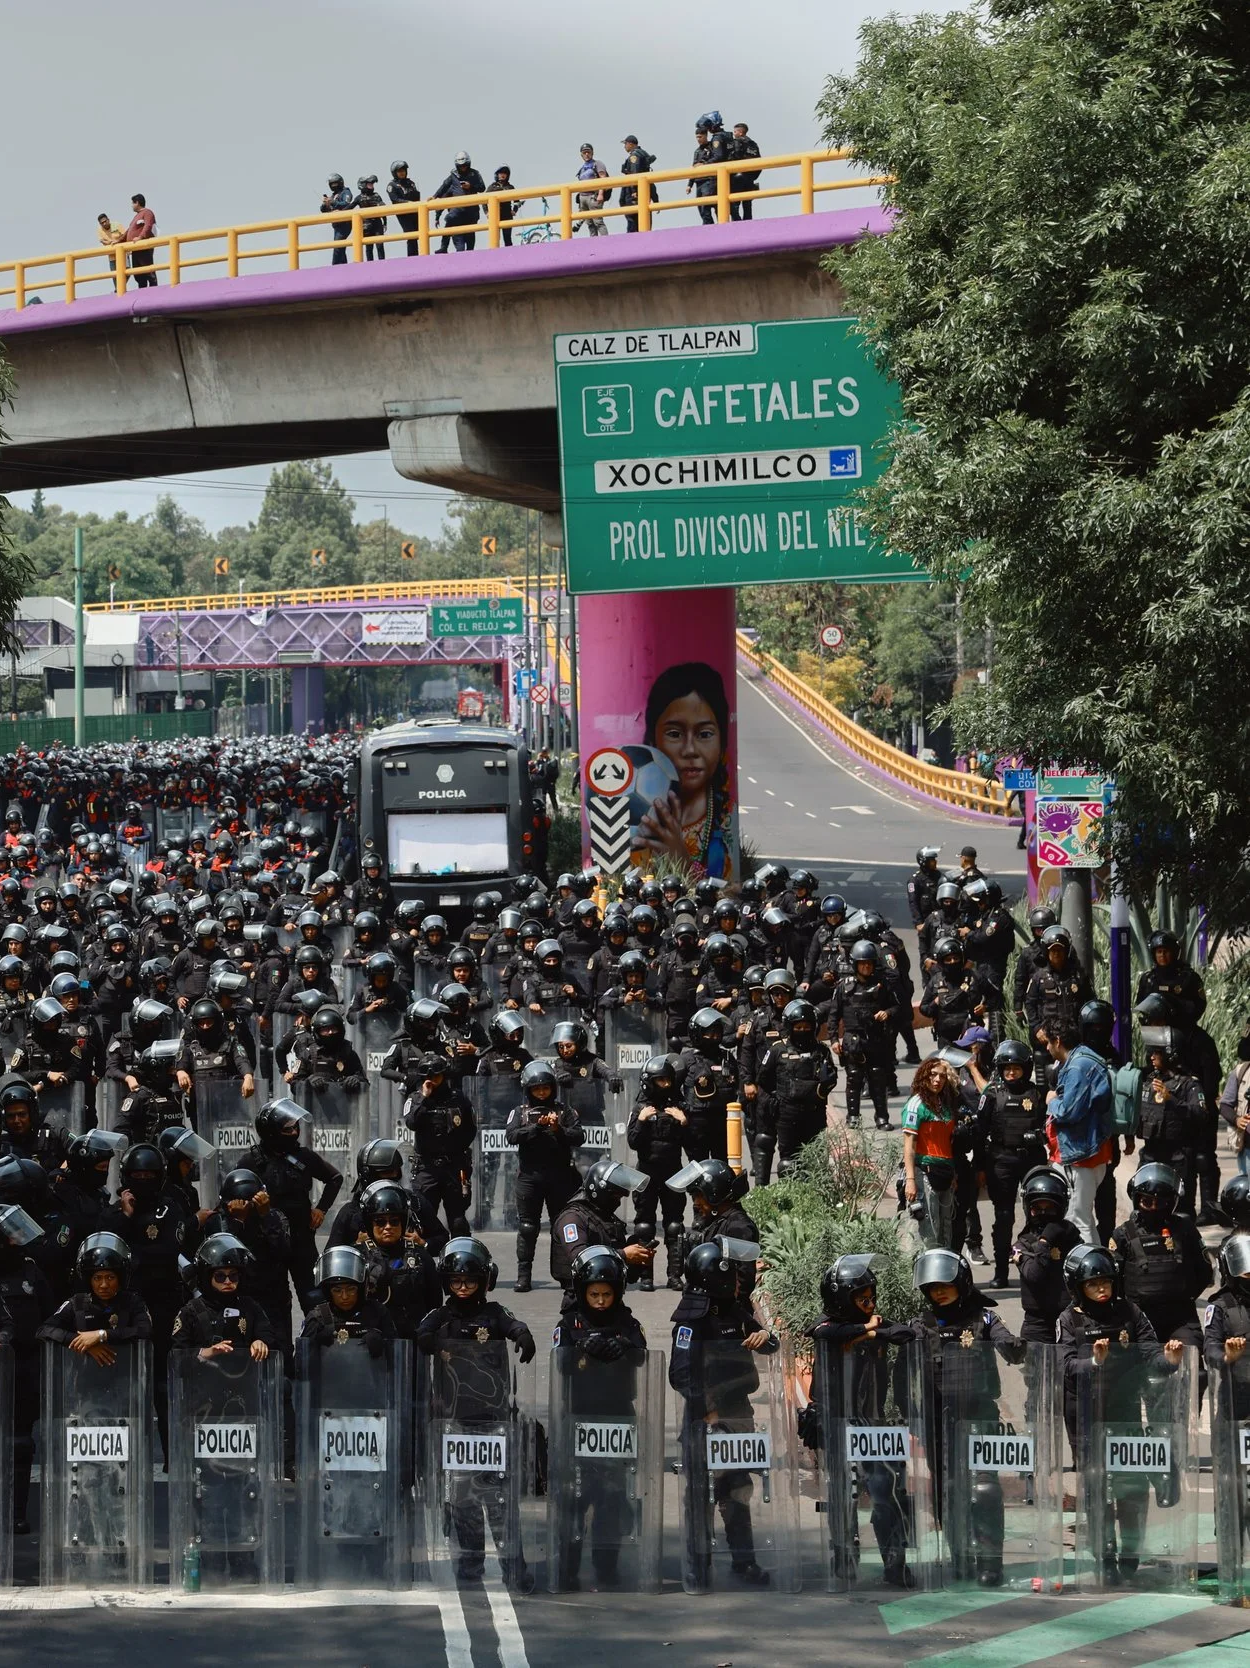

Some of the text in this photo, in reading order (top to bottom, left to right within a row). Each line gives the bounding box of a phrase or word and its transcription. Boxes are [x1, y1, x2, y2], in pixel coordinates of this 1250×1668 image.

[568, 330, 741, 357] CALZ DE TLALPAN
[597, 389, 615, 397] EJE
[654, 377, 860, 428] CAFETALES
[596, 398, 618, 425] 3
[599, 424, 616, 432] OTE
[608, 454, 817, 487] XOCHIMILCO
[610, 519, 665, 560] PROL
[675, 513, 767, 557] DIVISION
[778, 510, 818, 551] DEL
[456, 608, 516, 619] VIADUCTO TLALPAN
[438, 621, 499, 632] COL EL RELOJ
[418, 789, 467, 799] POLICIA
[620, 1049, 650, 1063] POLICIA
[218, 1130, 251, 1146] POLICIA
[315, 1131, 350, 1148] POLICIA
[483, 1134, 518, 1149] POLIC
[582, 1129, 610, 1145] OLICIA
[70, 1433, 124, 1456] POLICIA
[198, 1429, 253, 1454] POLICIA
[326, 1431, 378, 1457] POLICIA
[578, 1429, 633, 1453] POLICIA
[711, 1439, 767, 1464] POLICIA
[850, 1433, 906, 1457] POLICIA
[446, 1441, 502, 1466] POLICIA
[973, 1441, 1030, 1466] POLICIA
[1109, 1442, 1167, 1467] POLICIA
